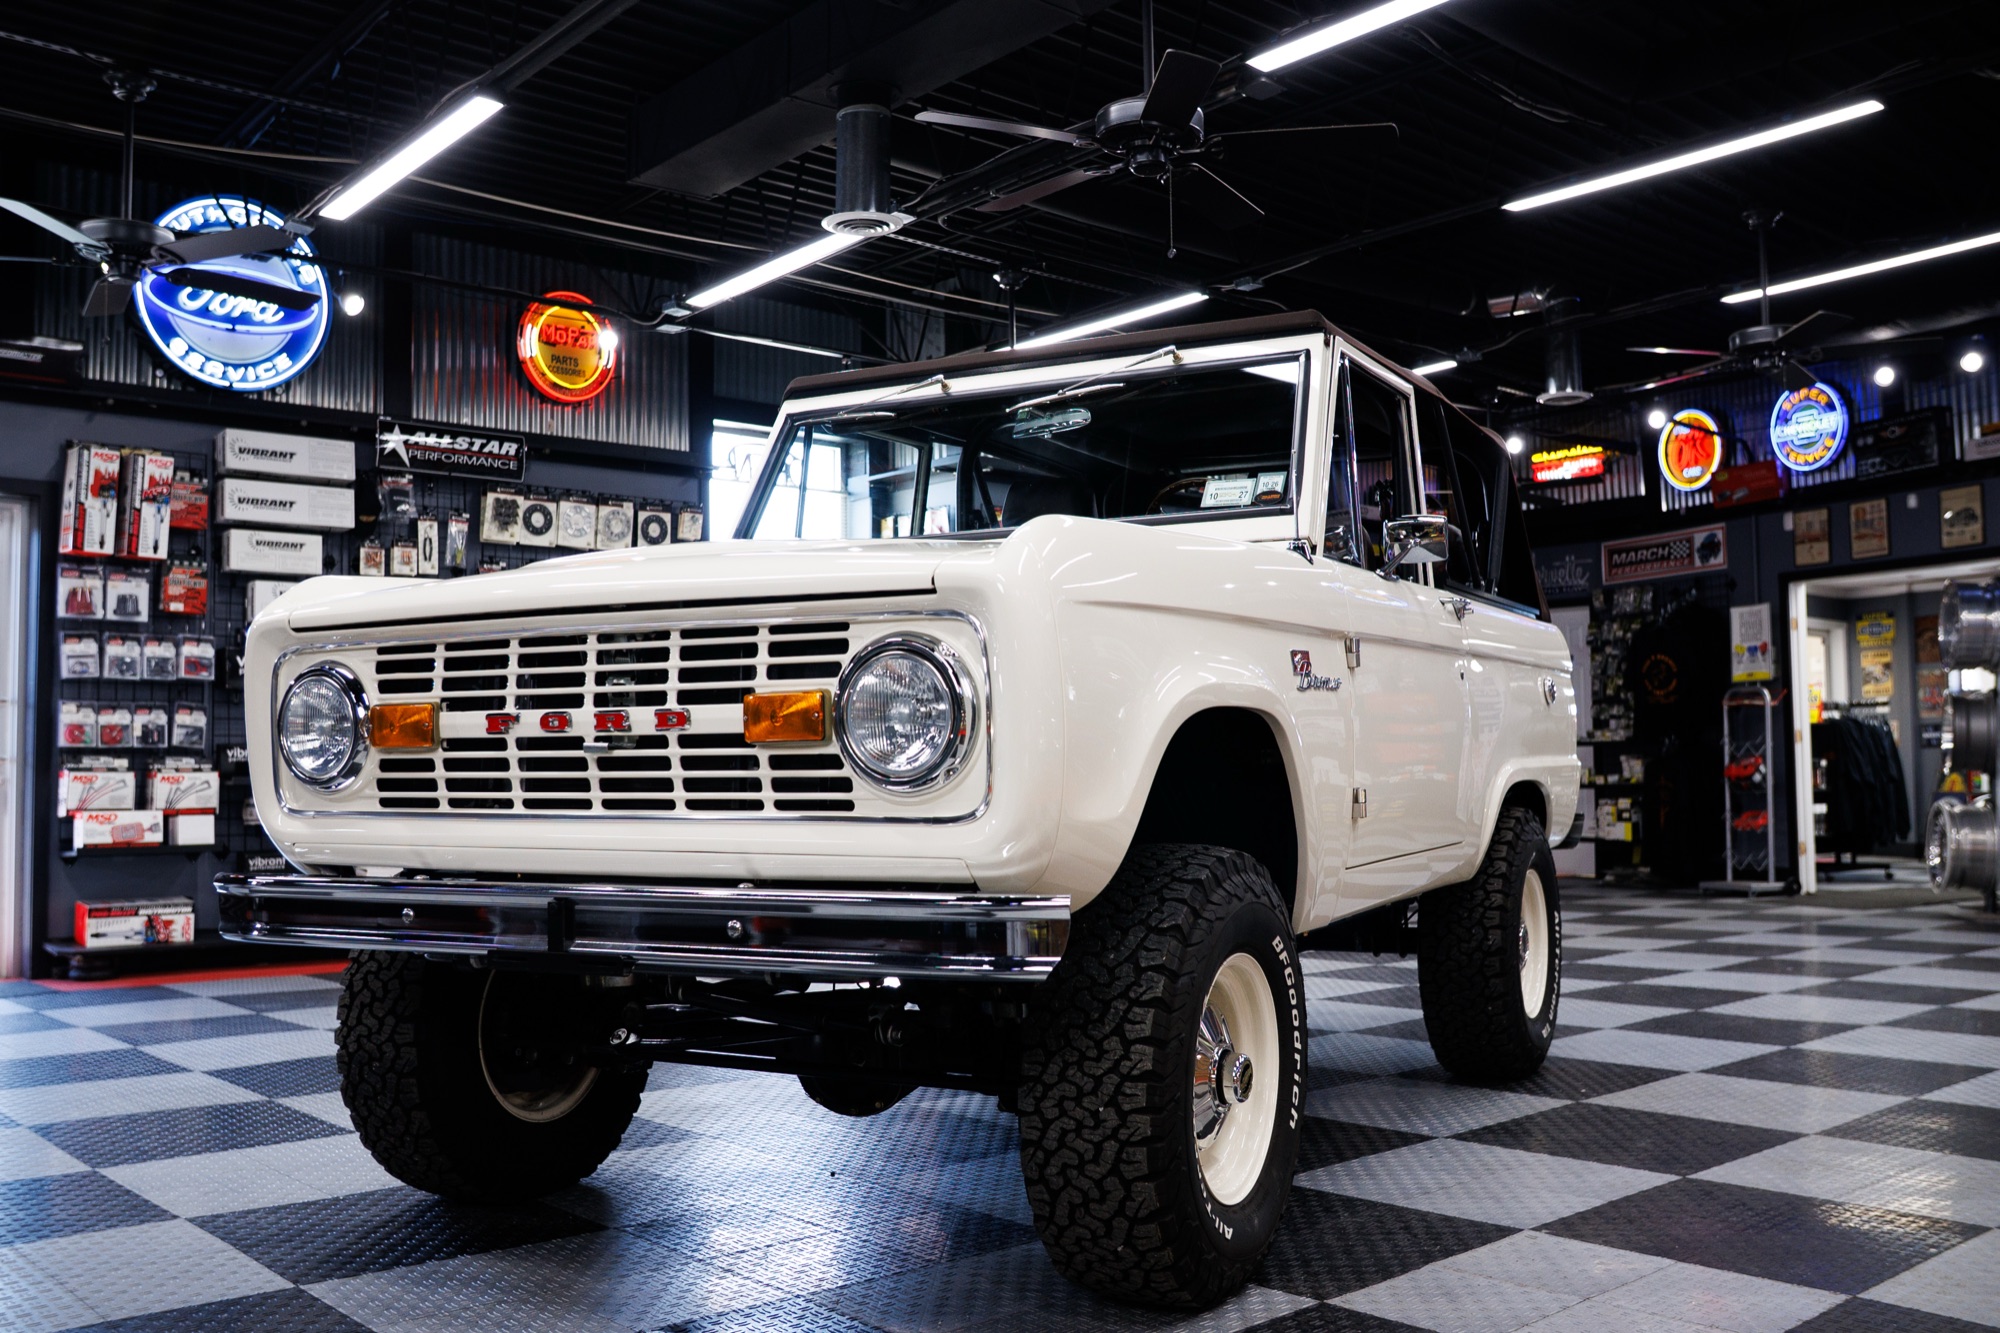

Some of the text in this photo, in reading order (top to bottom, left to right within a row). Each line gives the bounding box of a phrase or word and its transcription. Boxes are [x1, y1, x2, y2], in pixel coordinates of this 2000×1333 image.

[169, 338, 292, 382] SERVICE
[550, 354, 579, 367] PARTS
[1782, 387, 1828, 411] SUPER
[407, 431, 519, 457] ALLSTAR
[93, 451, 120, 461] MSD
[238, 446, 297, 460] VIBRANT
[408, 448, 518, 471] PERFORMANCE
[149, 457, 173, 468] MSD
[1209, 491, 1249, 500] 10 27
[237, 496, 297, 510] VIBRANT
[255, 539, 306, 551] VIBRANT
[1612, 545, 1670, 566] MARCH
[1611, 558, 1690, 576] PERFORMANCE
[485, 707, 692, 735] FORD
[72, 775, 98, 785] MSD
[160, 775, 185, 785] MSD
[86, 813, 118, 825] MSD
[1271, 935, 1302, 1130] BFGoodrich
